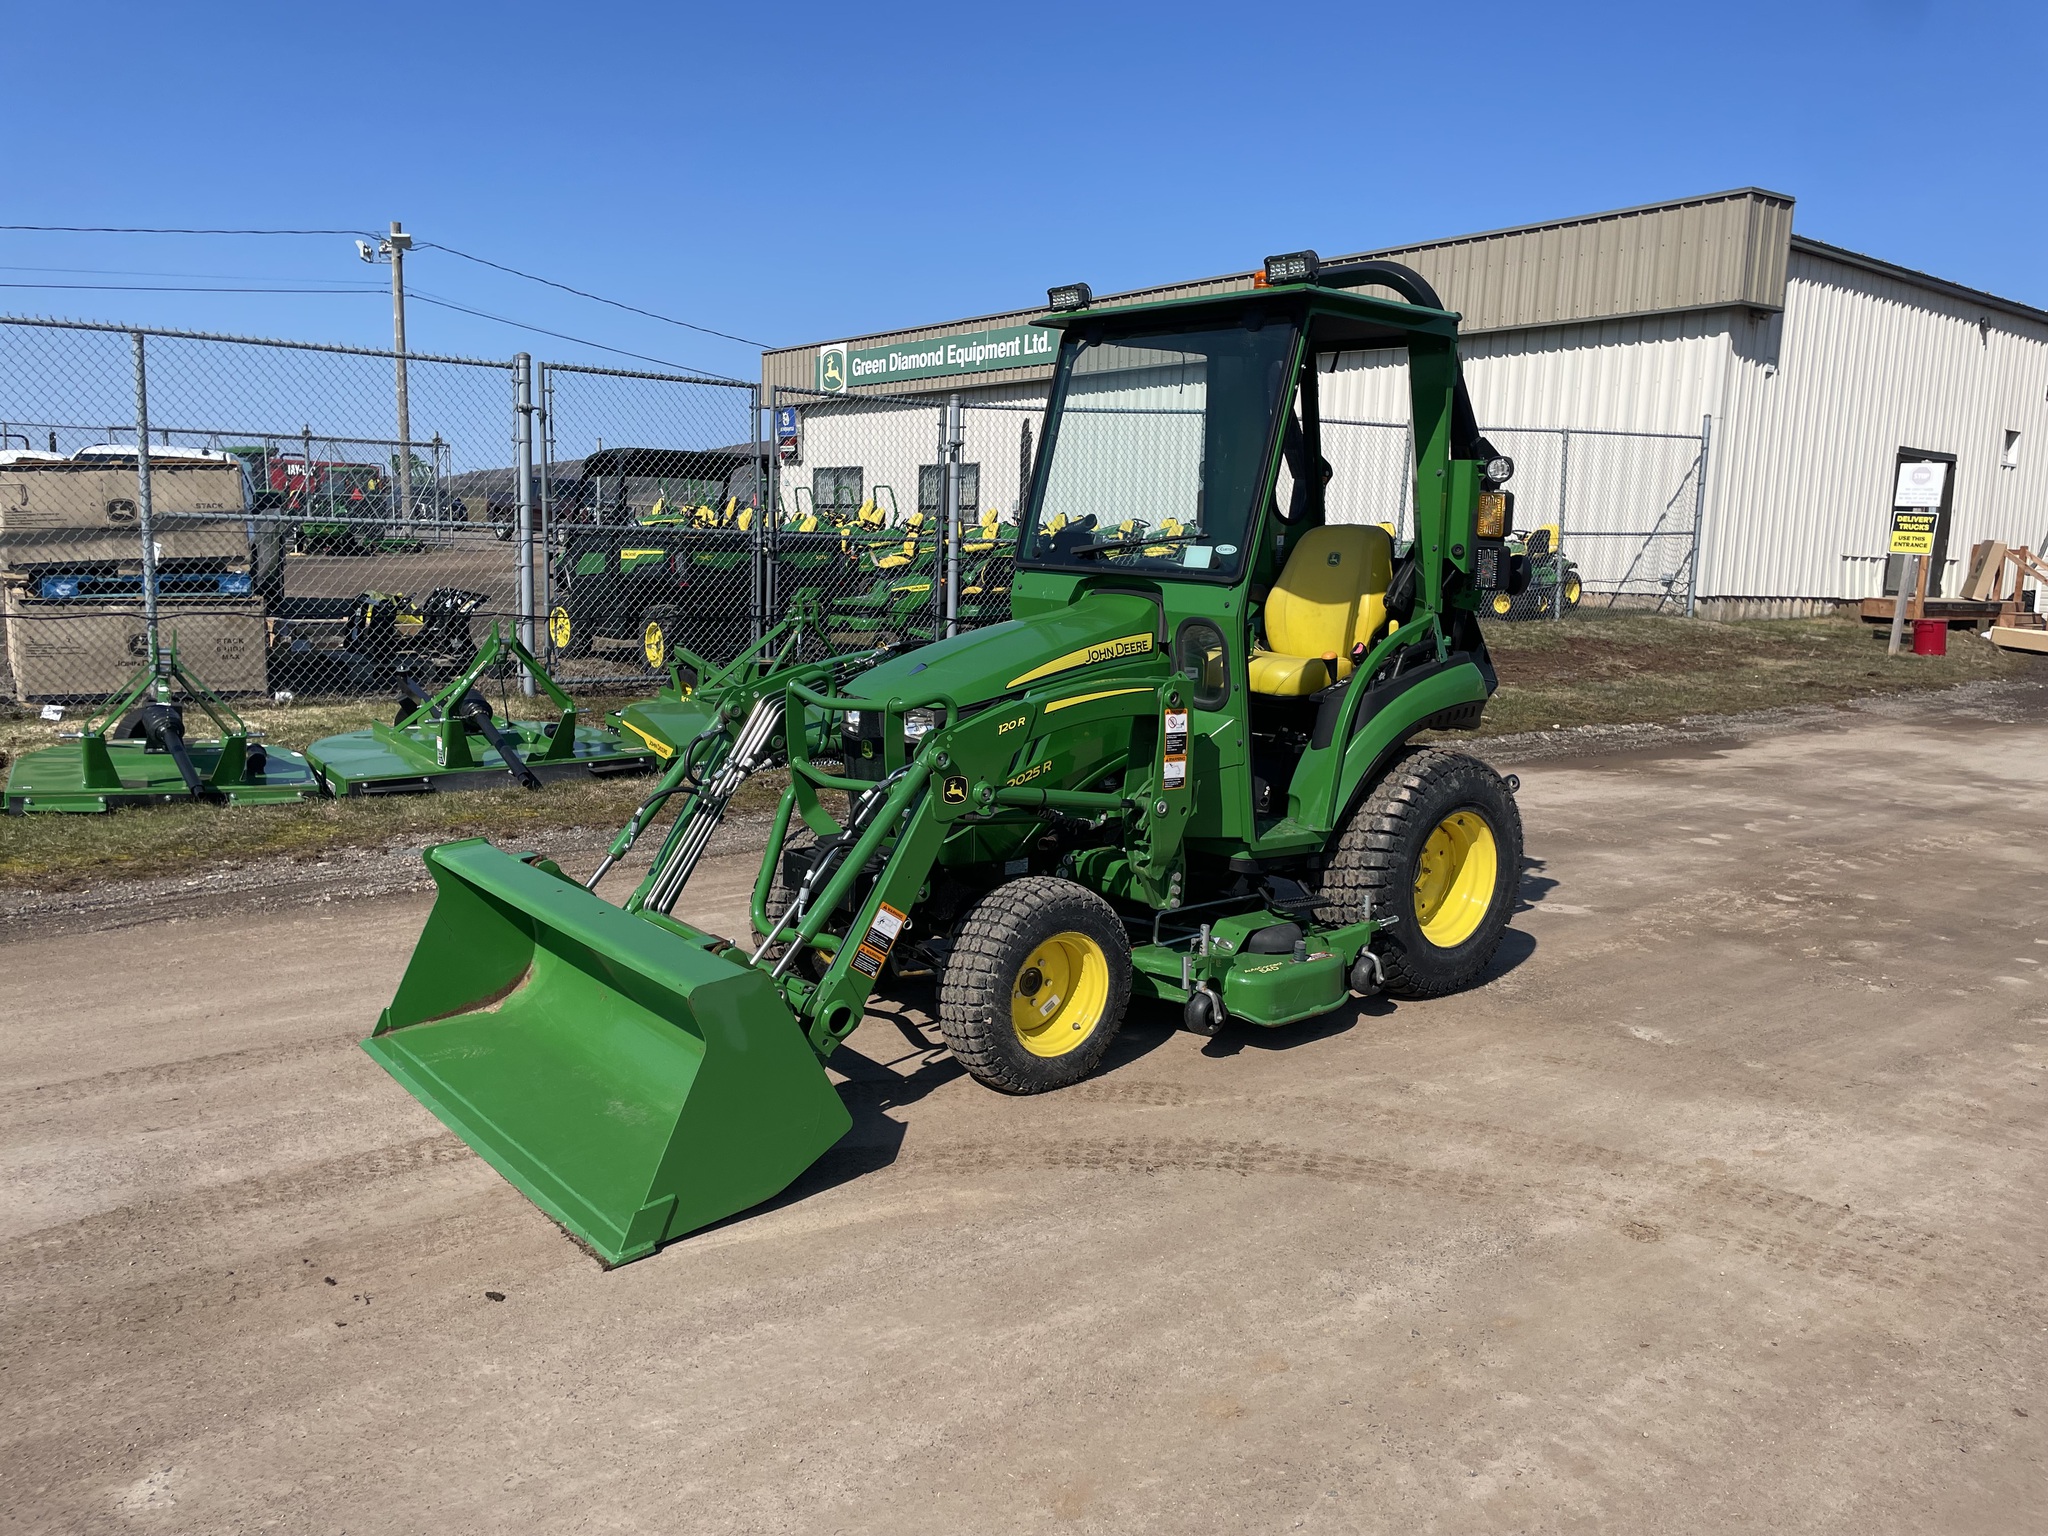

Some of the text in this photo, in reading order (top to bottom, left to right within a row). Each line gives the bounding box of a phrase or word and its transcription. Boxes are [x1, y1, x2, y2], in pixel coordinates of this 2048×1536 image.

[852, 331, 1052, 377] Green Diamond Equipment Ltd.
[1085, 640, 1149, 663] JOHN DEERE
[998, 716, 1026, 736] 120 R
[1042, 760, 1052, 774] R
